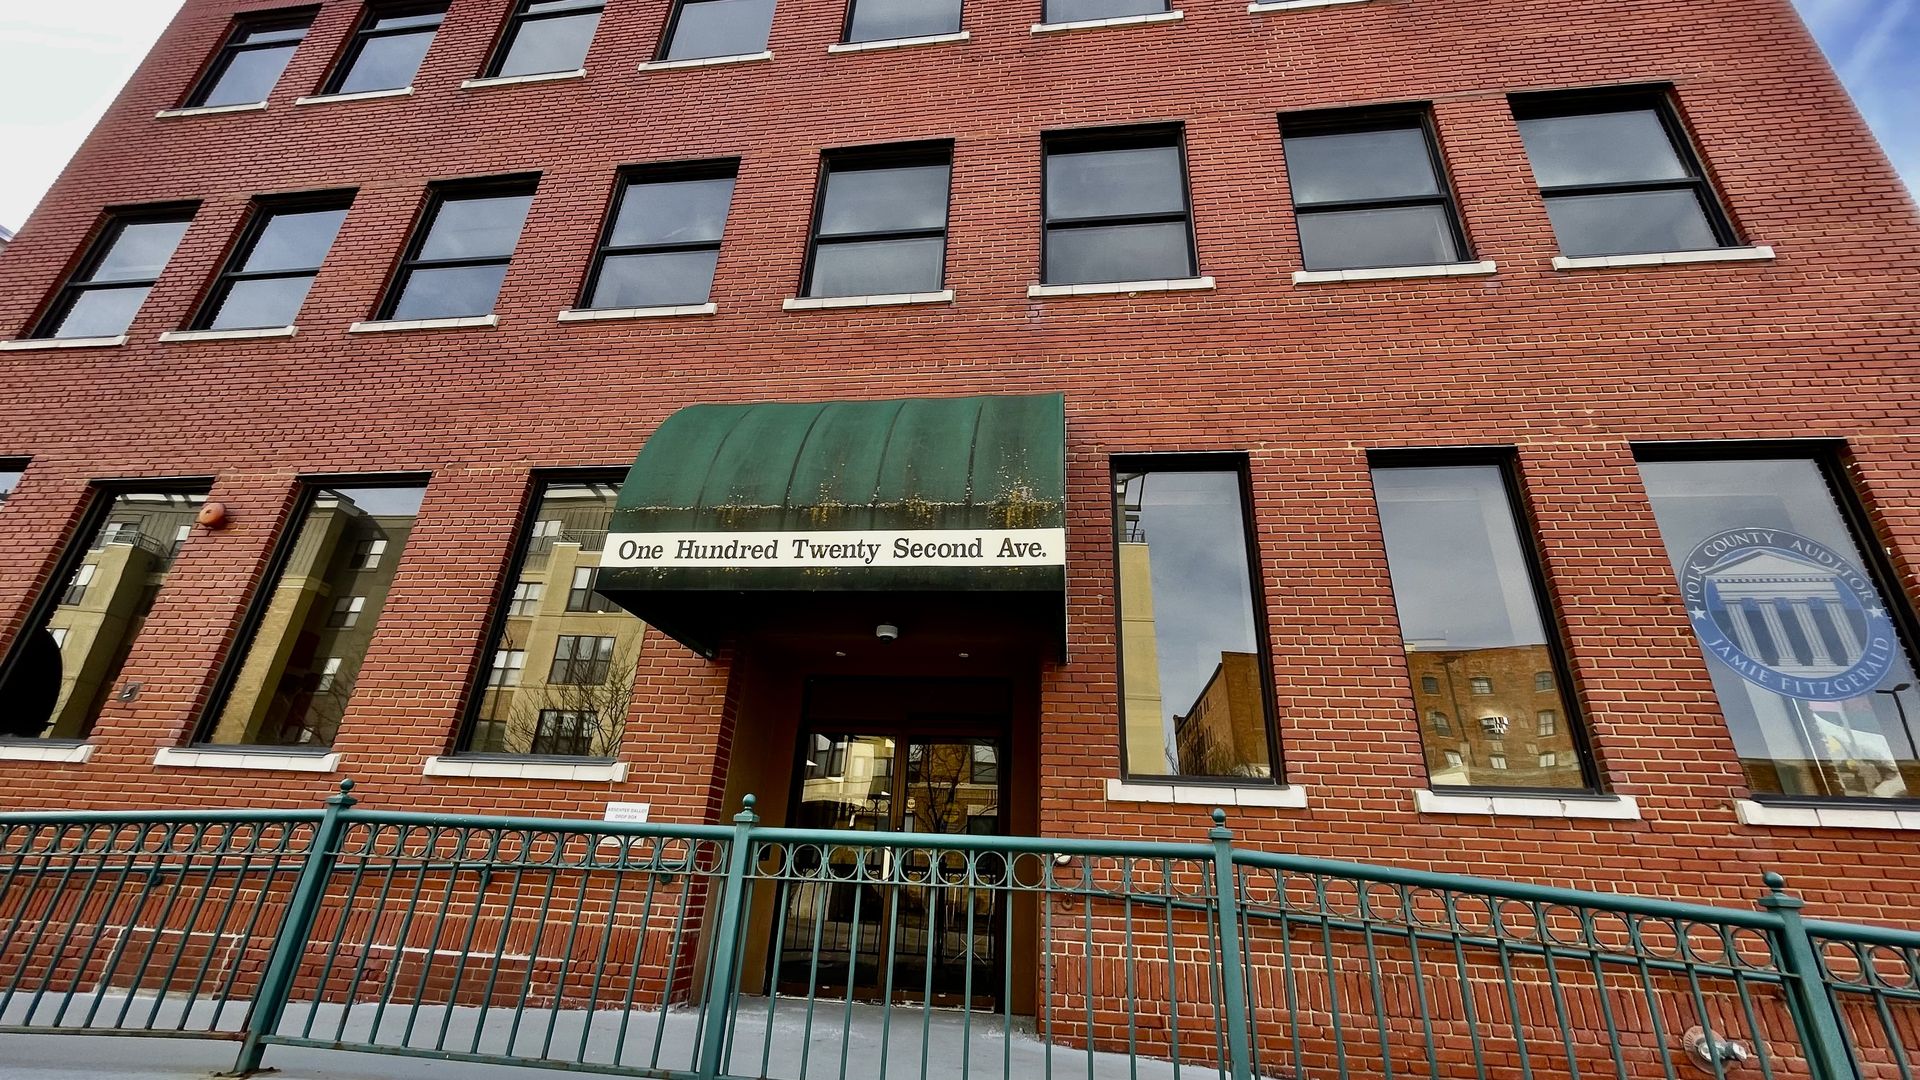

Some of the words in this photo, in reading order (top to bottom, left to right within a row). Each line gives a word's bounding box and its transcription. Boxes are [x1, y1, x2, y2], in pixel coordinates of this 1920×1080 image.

[618, 539, 664, 560] One
[674, 539, 779, 560] Hundred
[791, 538, 881, 564] Twenty
[893, 537, 984, 559] Second
[996, 537, 1047, 558] Ave.
[1687, 563, 1706, 603] POLK
[1703, 532, 1775, 558] COUNTY
[1790, 540, 1874, 602] AUDITOR
[1708, 638, 1769, 684] JAMIE
[1781, 637, 1890, 696] FITZGERALD
